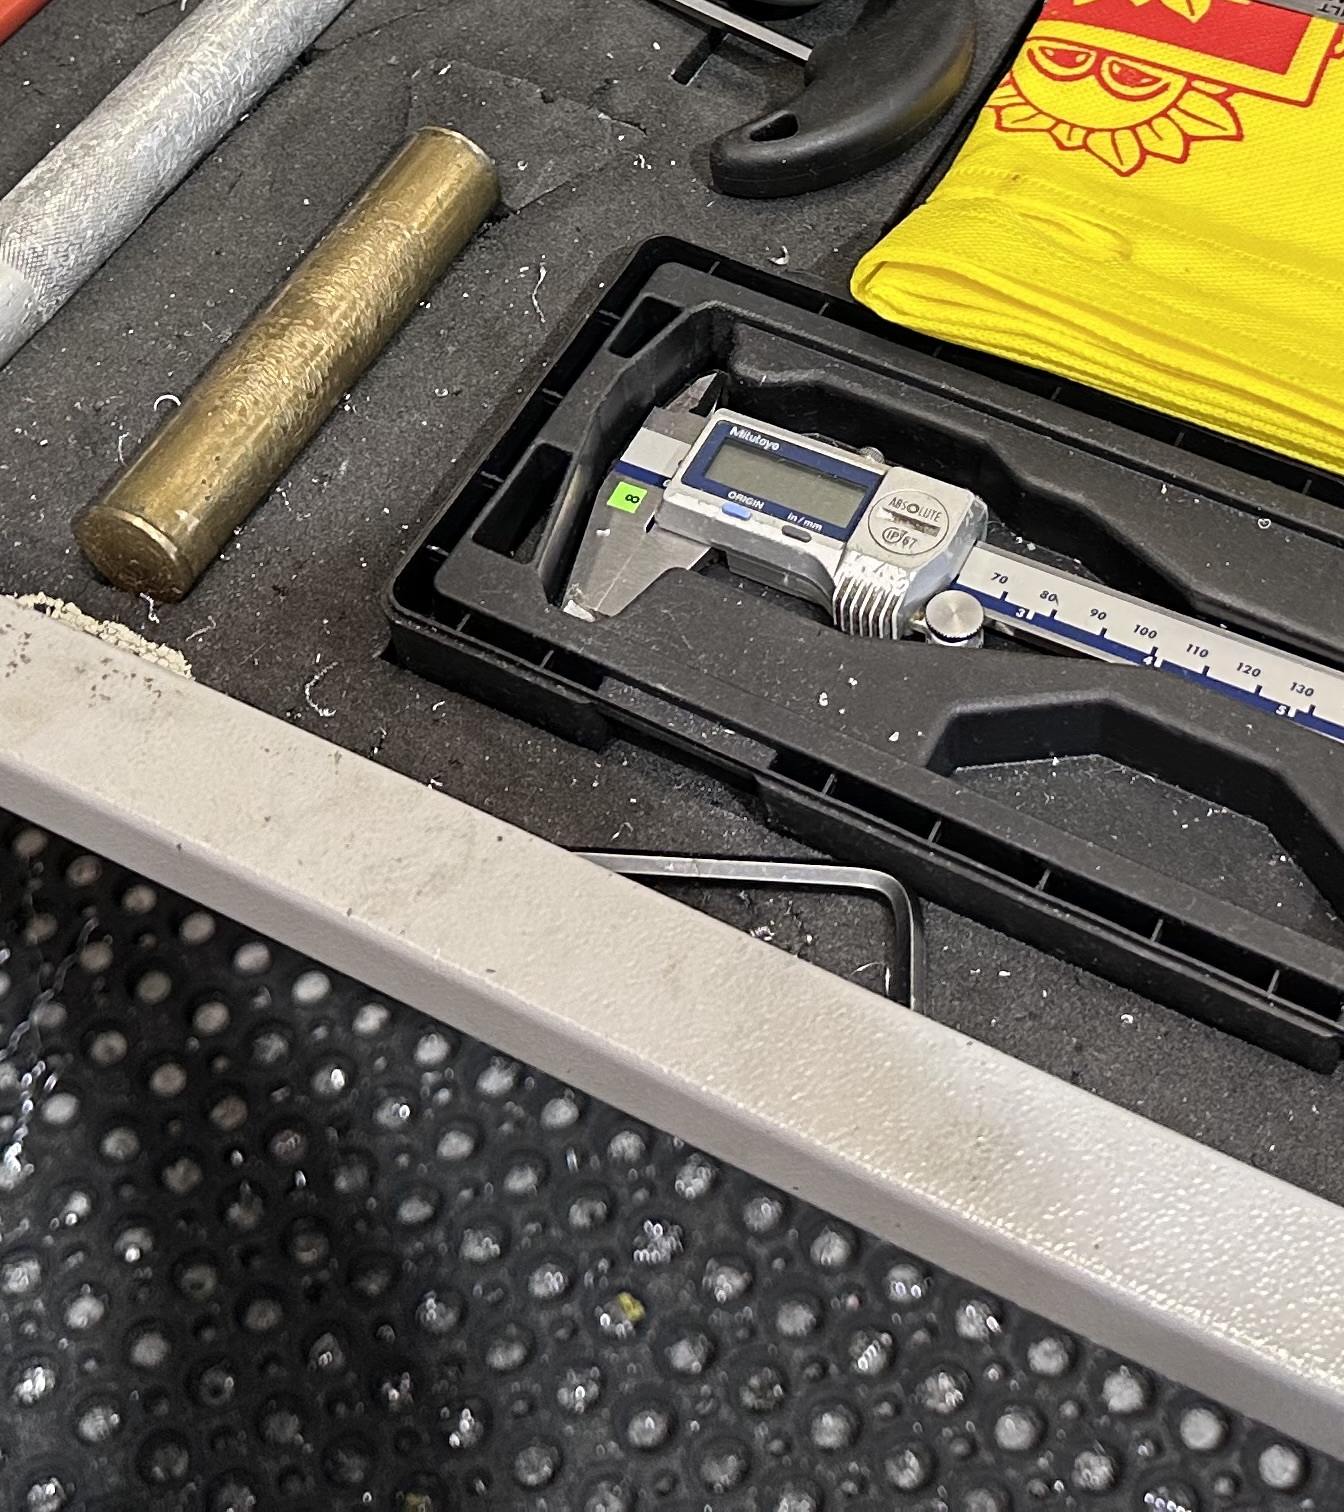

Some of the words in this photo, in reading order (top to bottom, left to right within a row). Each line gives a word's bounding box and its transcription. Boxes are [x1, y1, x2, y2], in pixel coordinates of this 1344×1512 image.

[729, 426, 781, 452] Mitutoyo
[624, 493, 641, 505] 8
[727, 490, 766, 510] ORIGIN
[888, 496, 943, 523] ABSOLUTE
[990, 572, 1009, 585] 70
[1039, 590, 1057, 603] 80
[1089, 608, 1107, 621] 90
[1132, 623, 1158, 640] 100
[1185, 643, 1209, 659] 110
[1235, 661, 1262, 678] 120
[1289, 681, 1315, 698] 130
[1015, 607, 1026, 618] 3
[1142, 655, 1154, 666] 4
[1275, 705, 1288, 717] 5
